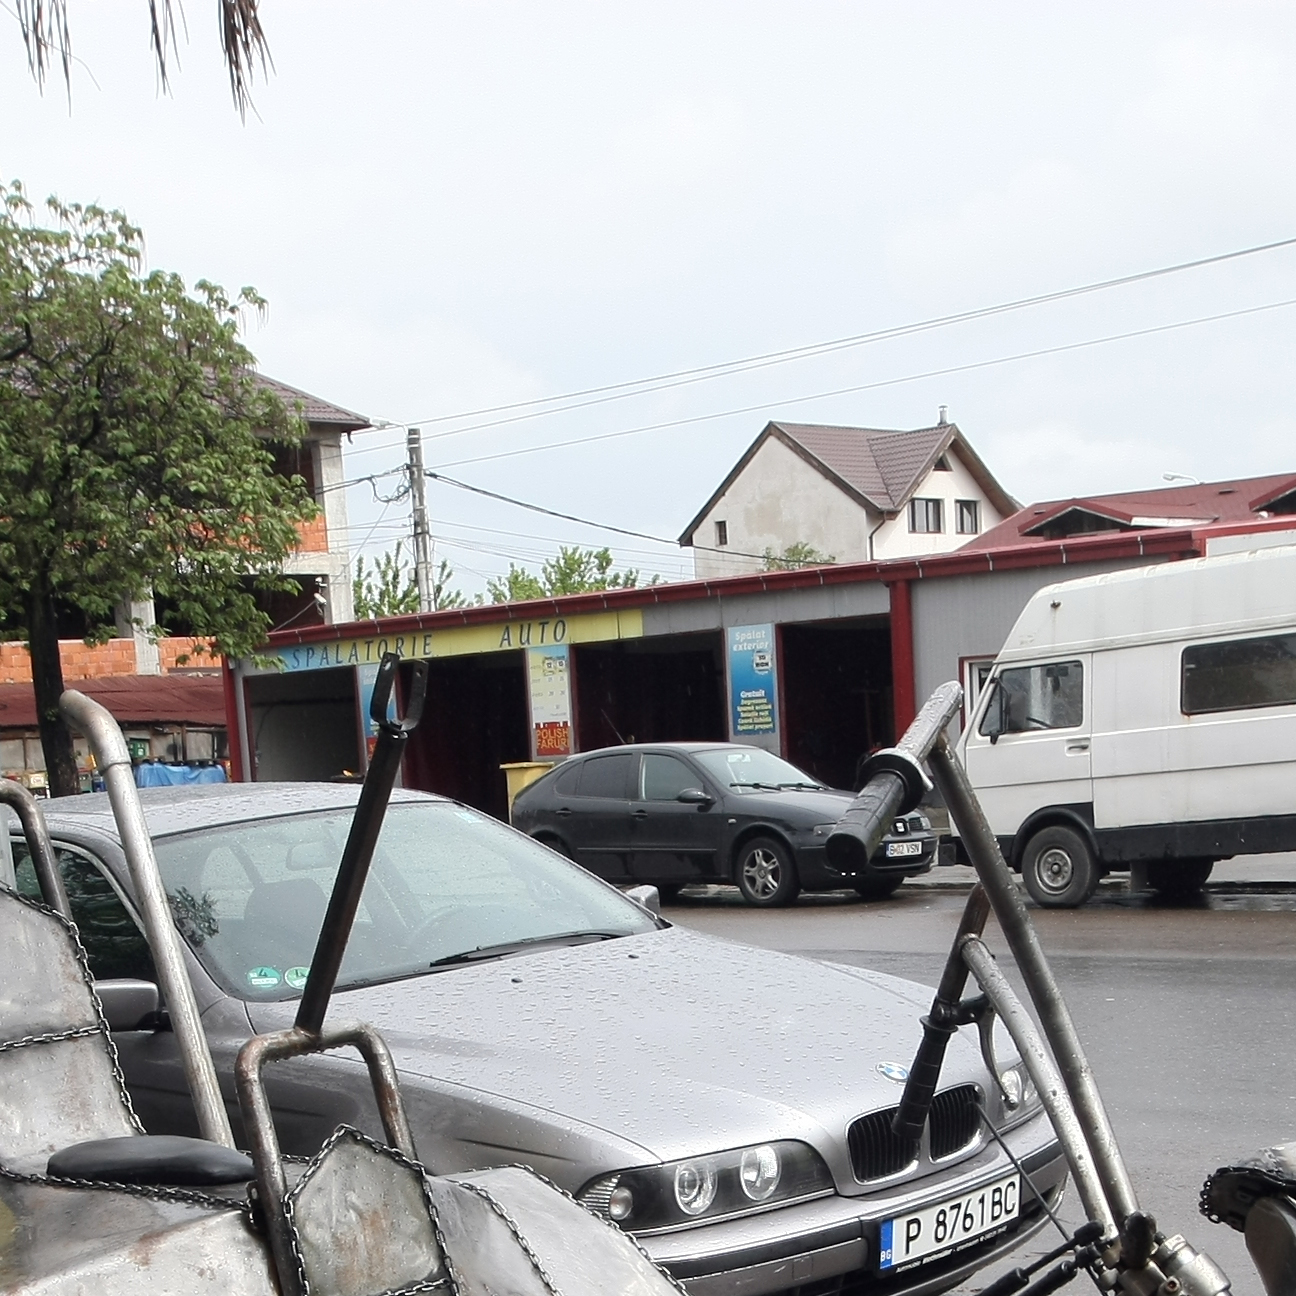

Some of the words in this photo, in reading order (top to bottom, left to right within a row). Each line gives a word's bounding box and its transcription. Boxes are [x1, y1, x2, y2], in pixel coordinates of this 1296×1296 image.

[500, 619, 567, 649] AUTO
[733, 641, 769, 652] exterior
[536, 727, 569, 741] POLISH
[905, 1217, 922, 1255] P
[880, 1250, 892, 1263] BG
